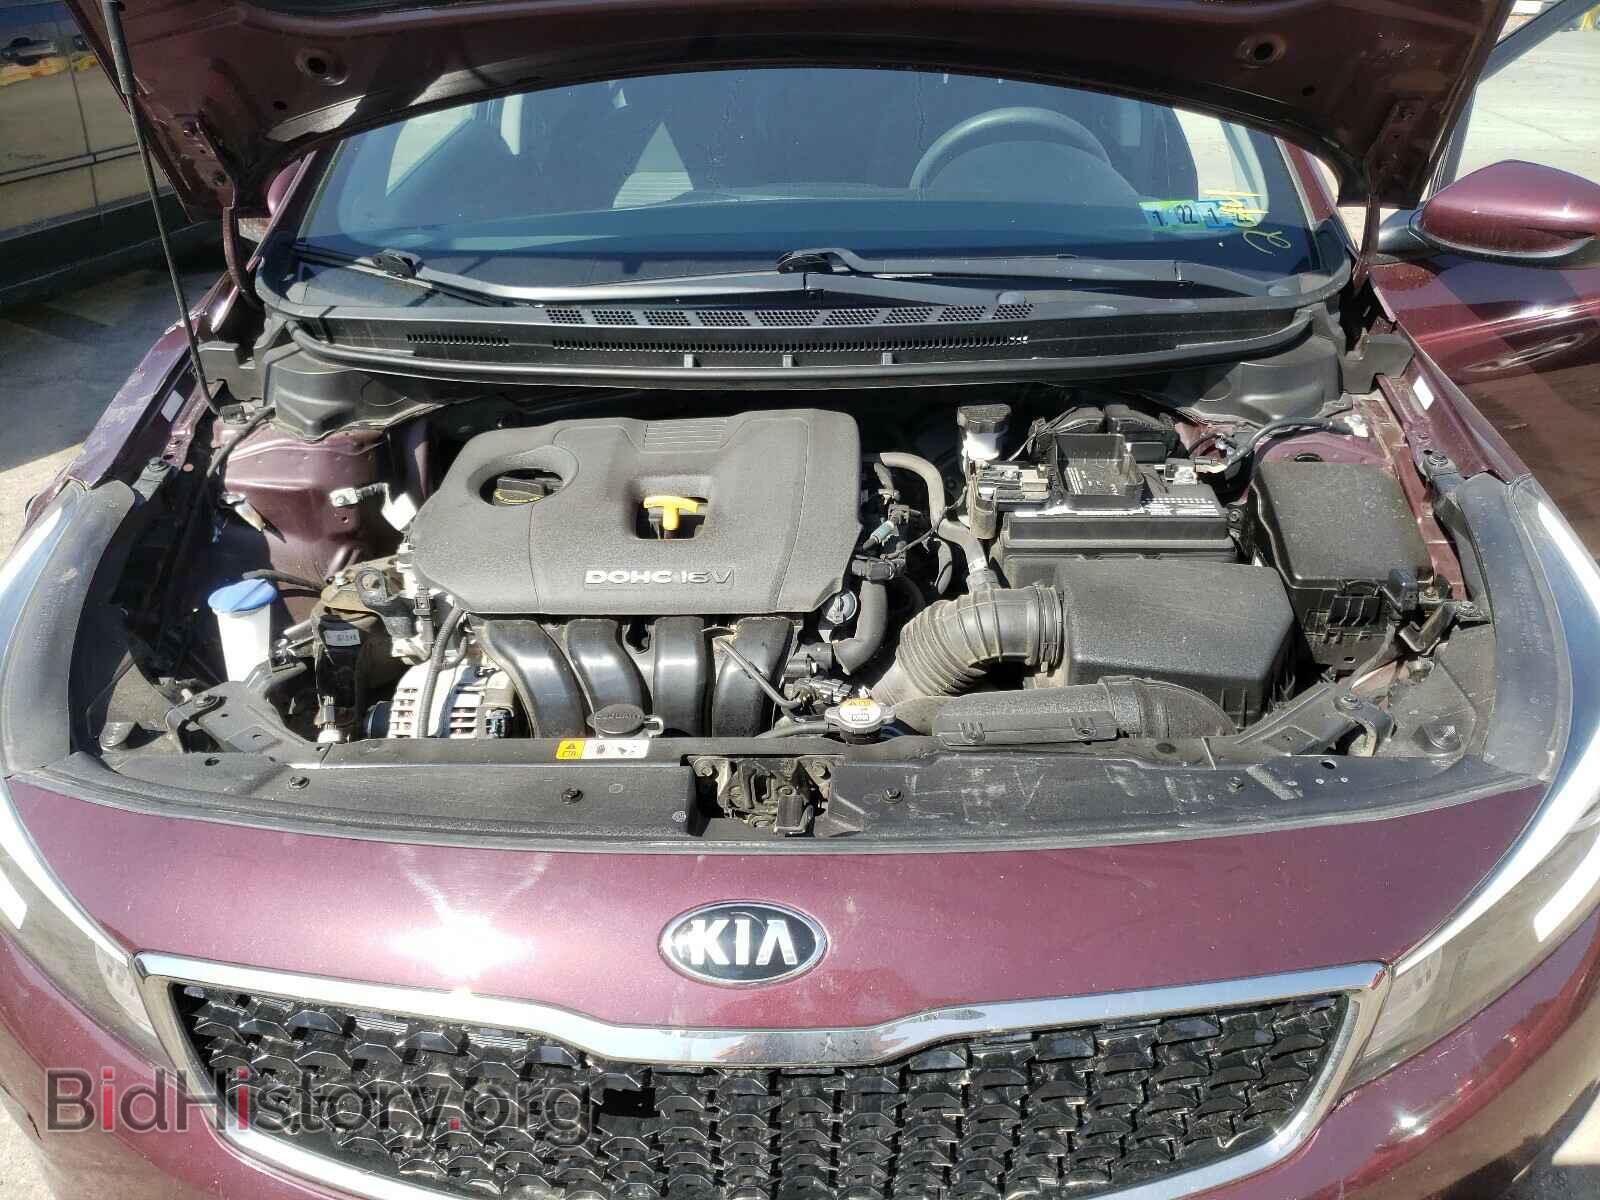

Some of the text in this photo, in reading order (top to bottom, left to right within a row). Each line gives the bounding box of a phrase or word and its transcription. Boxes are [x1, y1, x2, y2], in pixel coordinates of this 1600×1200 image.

[1175, 204, 1199, 224] 22
[584, 570, 673, 585] DOHC
[689, 918, 799, 967] KIA
